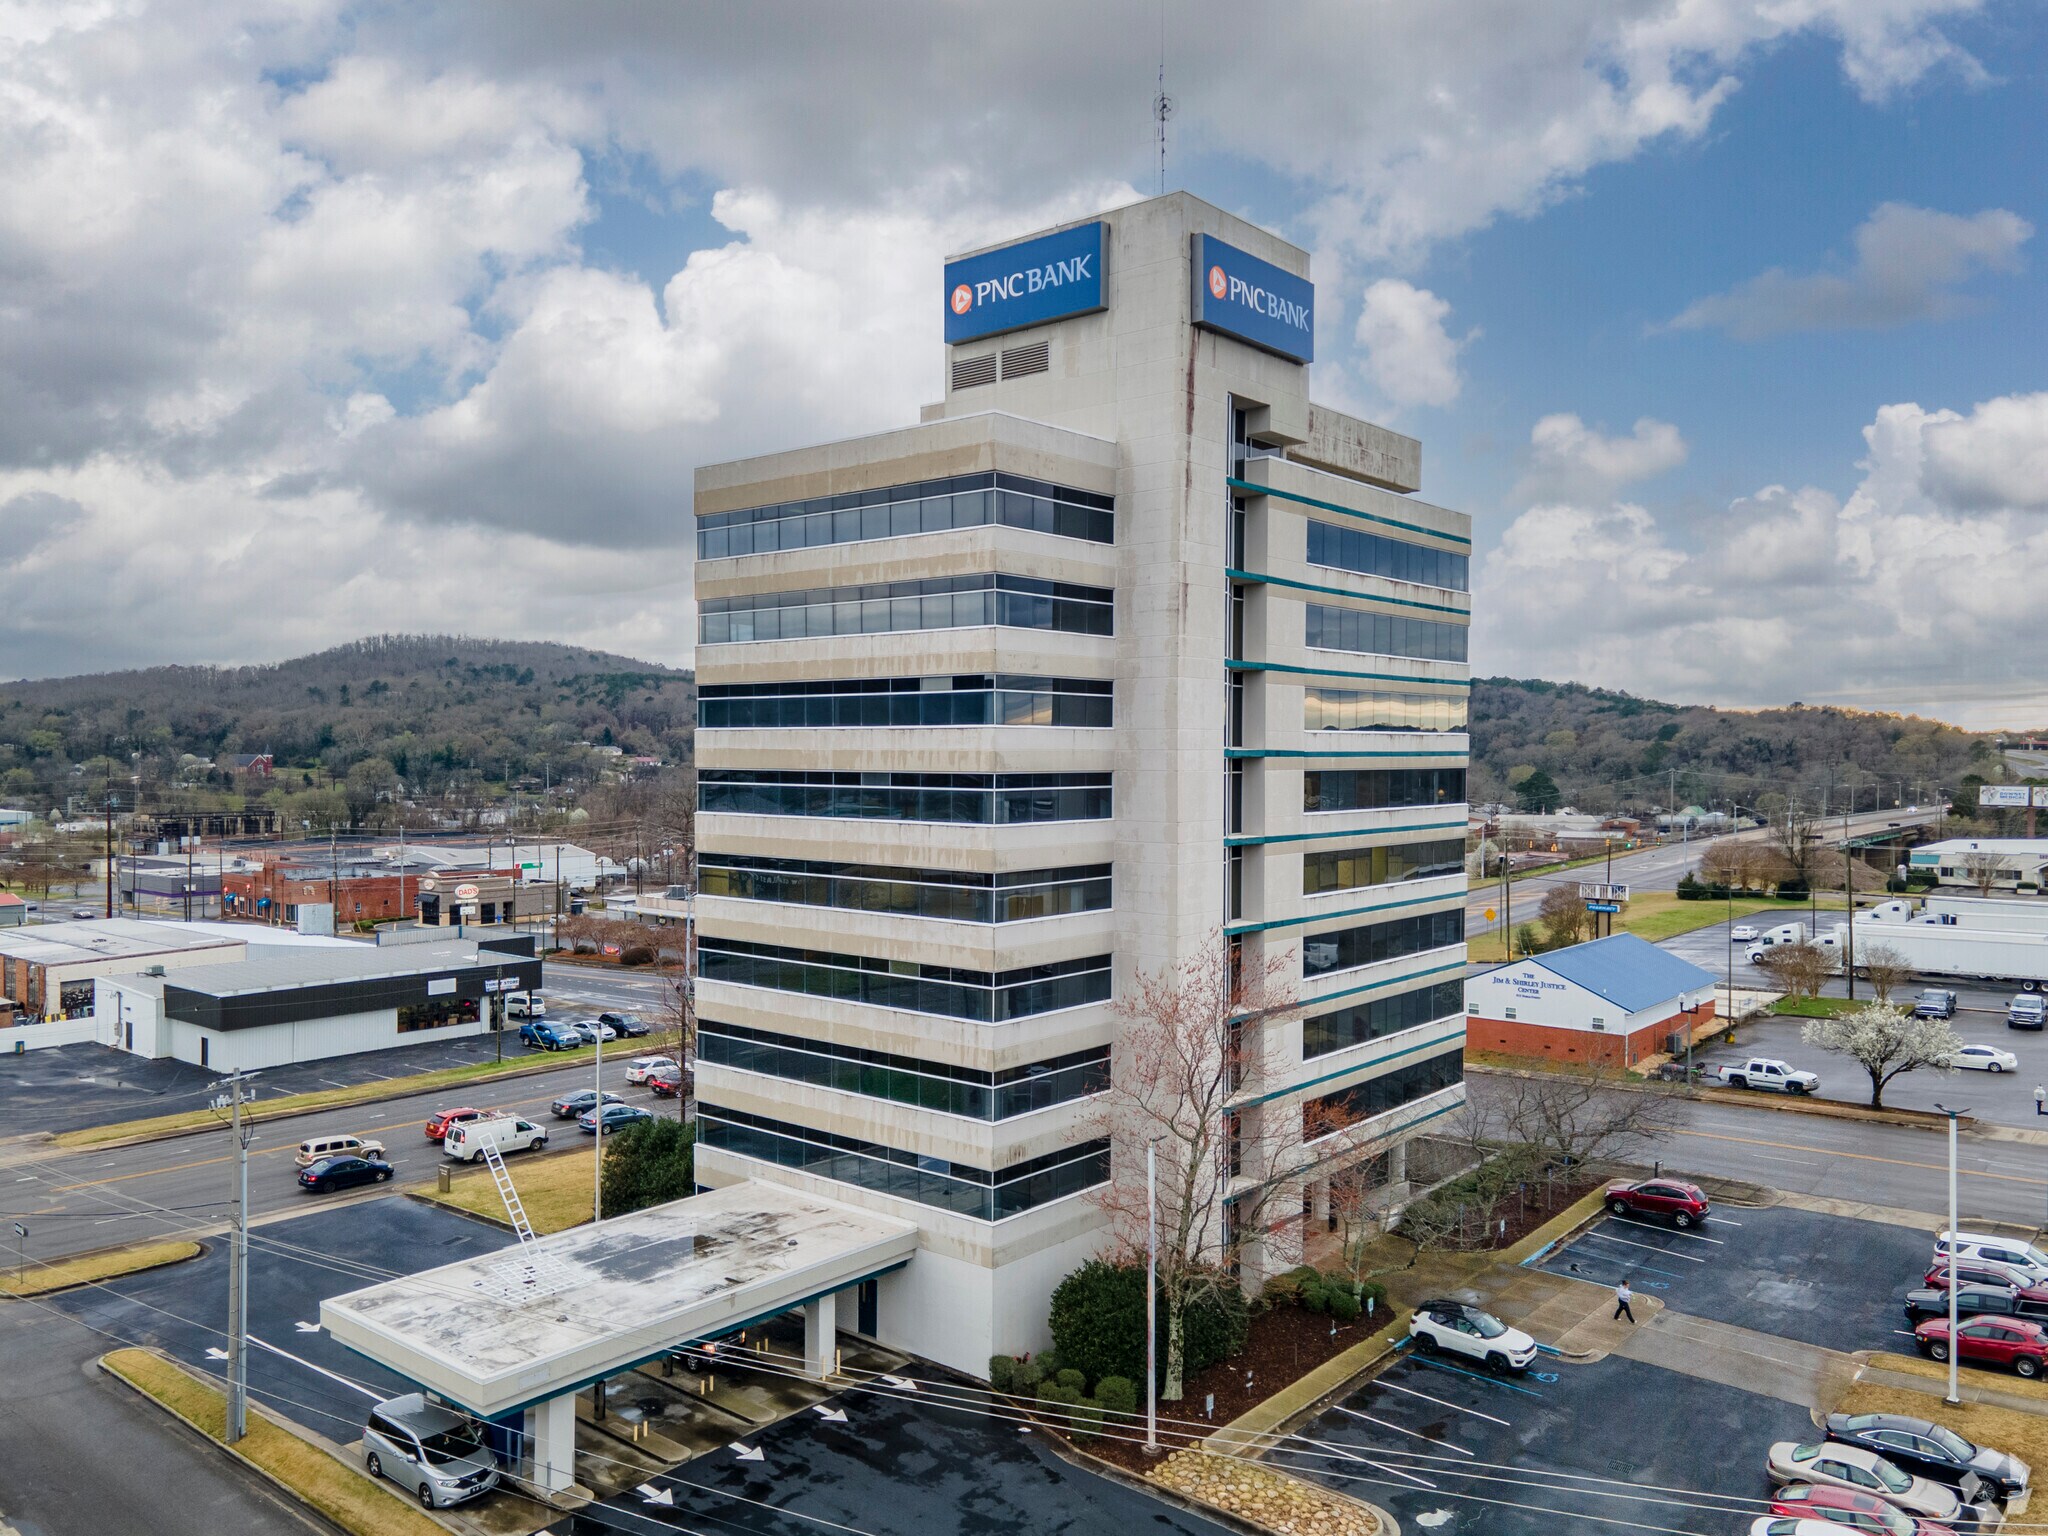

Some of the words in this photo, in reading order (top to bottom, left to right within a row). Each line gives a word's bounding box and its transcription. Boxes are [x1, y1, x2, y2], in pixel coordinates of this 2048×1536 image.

[975, 273, 1024, 306] PNC
[1026, 253, 1092, 293] BANK
[1228, 275, 1266, 314] PNC
[1266, 292, 1310, 332] BANK
[458, 888, 477, 896] DAD'S
[1512, 978, 1540, 988] SHIRLEY
[1540, 981, 1567, 990] JUSTICE
